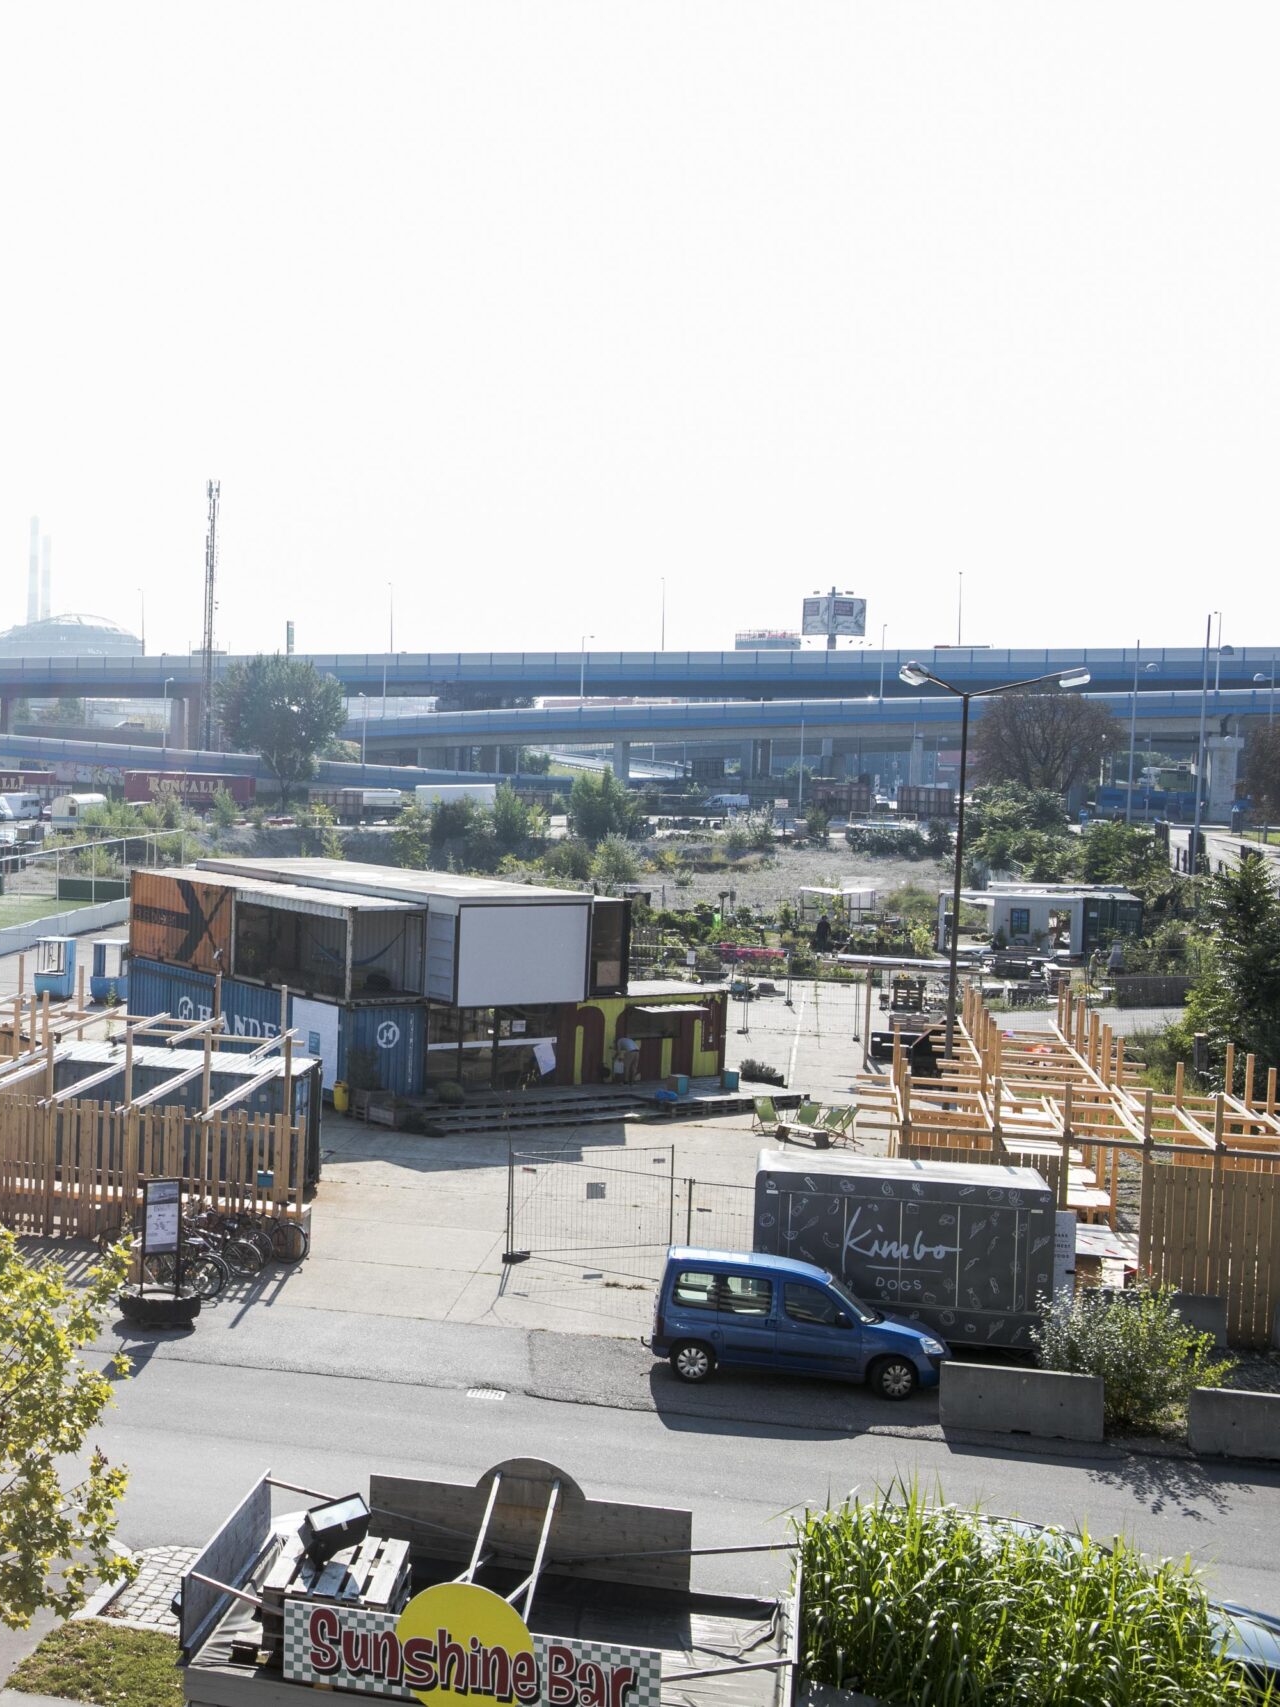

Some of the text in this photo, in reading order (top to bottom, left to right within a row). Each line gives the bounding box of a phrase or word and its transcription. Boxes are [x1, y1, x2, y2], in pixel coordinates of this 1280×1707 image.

[147, 776, 225, 793] RONCALLI
[197, 1005, 284, 1039] HANDE
[842, 1206, 963, 1274] Kimbo
[875, 1276, 922, 1292] DOGS
[308, 1607, 636, 1707] Sunshine Bar
